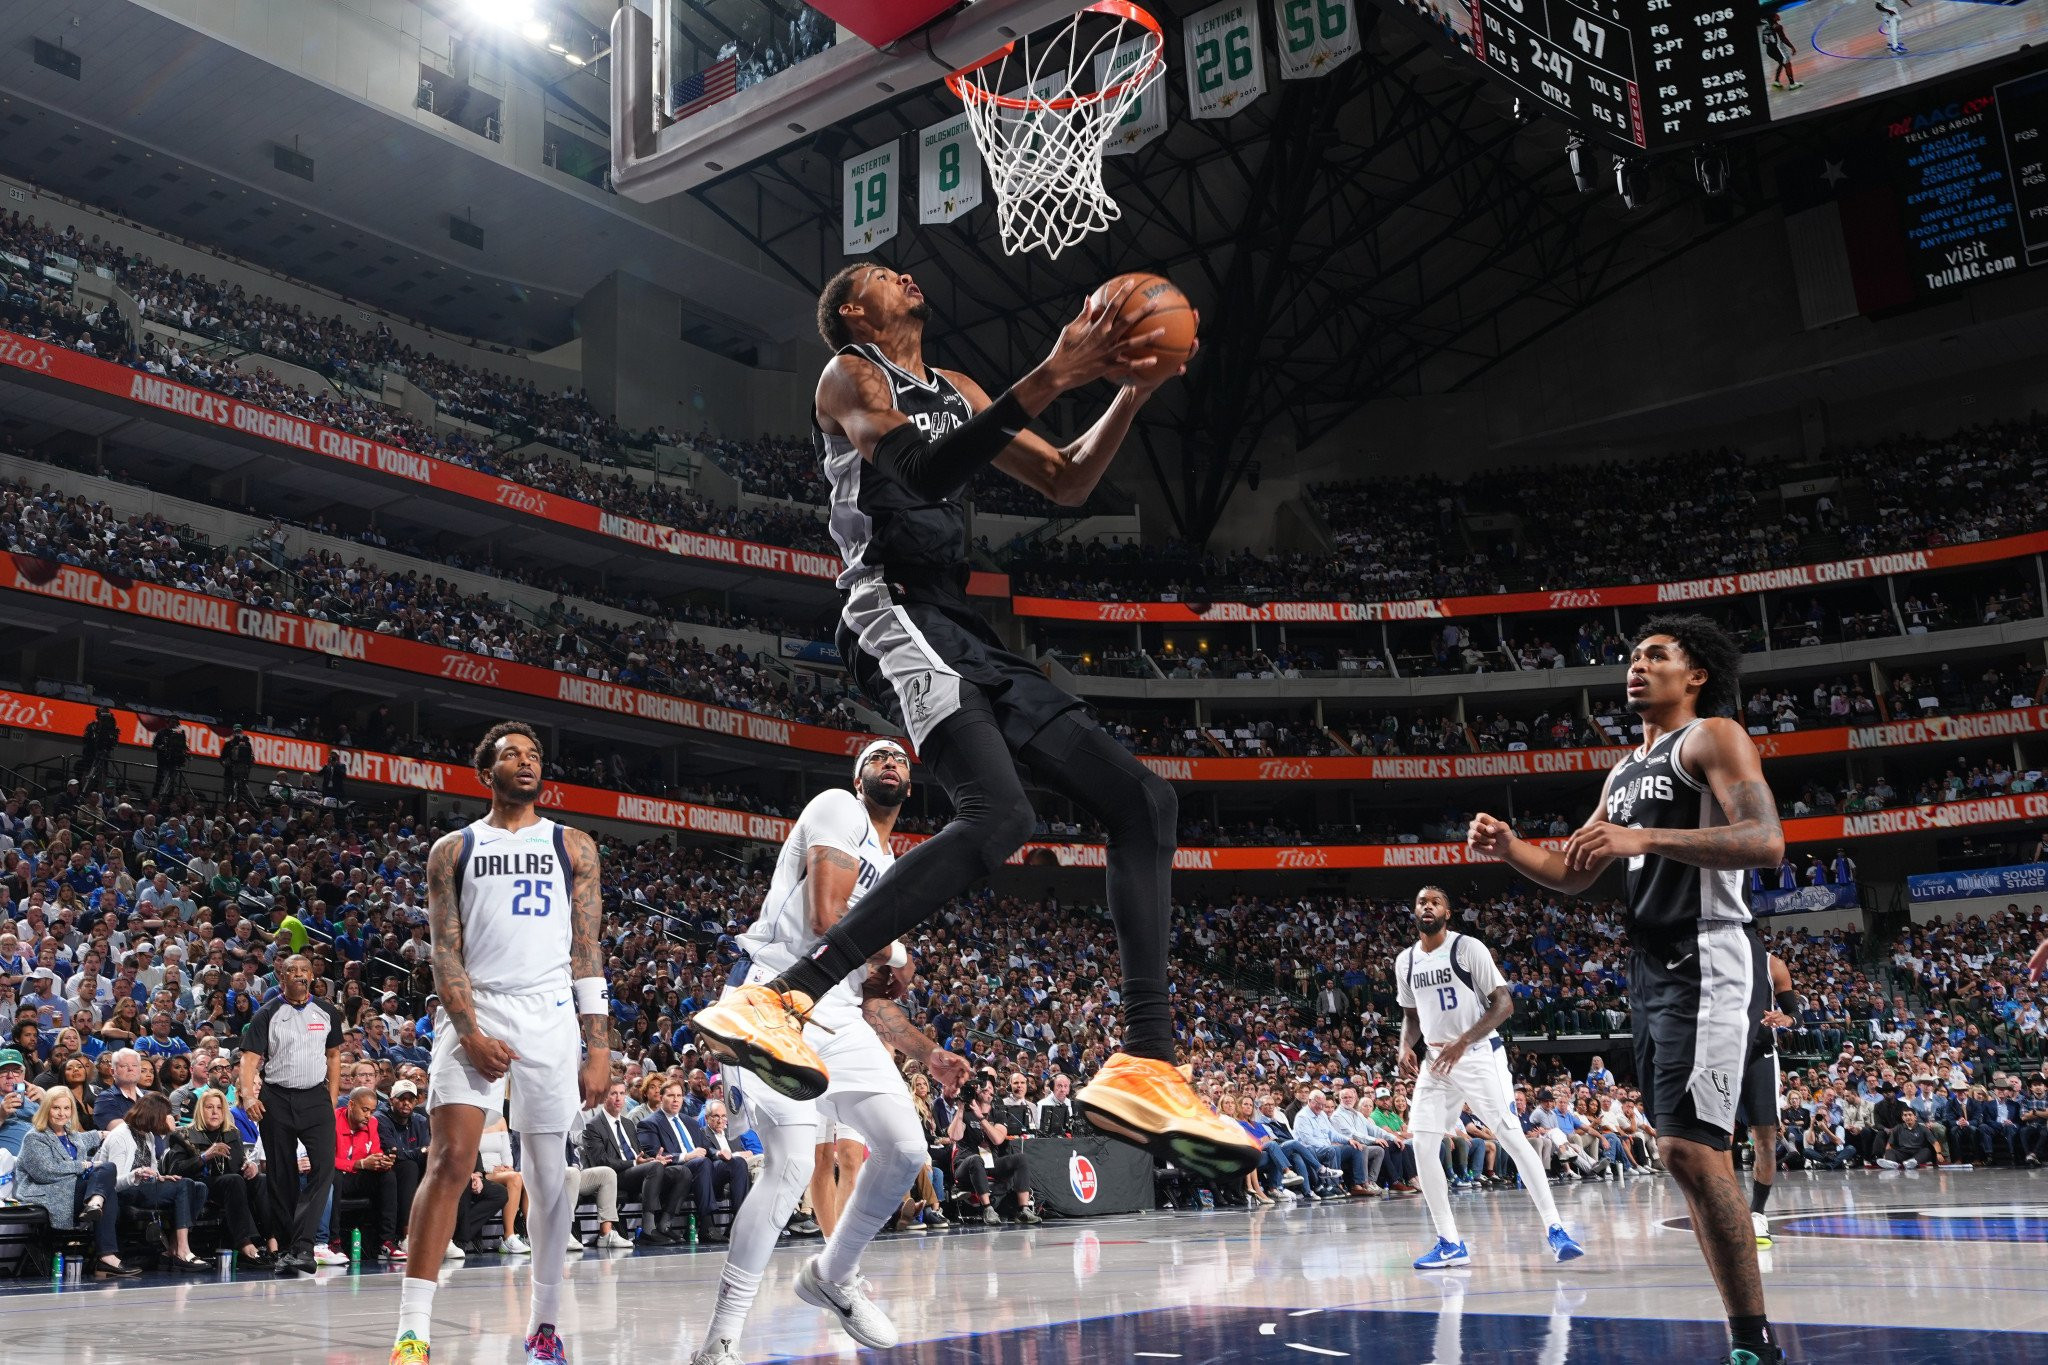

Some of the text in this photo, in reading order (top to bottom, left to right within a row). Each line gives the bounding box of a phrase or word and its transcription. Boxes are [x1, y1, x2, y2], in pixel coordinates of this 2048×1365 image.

[1197, 6, 1243, 36] LEHTINEN
[1284, 0, 1347, 54] 56
[1483, 12, 1516, 44] TOL 5
[1650, 7, 1735, 37] FG 19/36
[1333, 45, 1352, 58] 2009
[1573, 16, 1606, 60] 47
[1653, 28, 1728, 55] 3-PT 3/8
[1196, 25, 1253, 93] 26
[1489, 42, 1520, 74] FLS 5
[1529, 38, 1574, 85] 2:47
[1655, 43, 1735, 72] FT 6/13
[1588, 74, 1623, 102] TOL 5
[1658, 69, 1747, 98] FG 52.8%
[1630, 86, 1643, 143] BONUS
[1661, 87, 1749, 116] 3-PT 37.5%
[1592, 103, 1627, 130] FLS 5
[1663, 105, 1752, 133] FT 46.2%
[1904, 113, 1984, 144] TELL US ABOUT
[1921, 132, 1970, 153] FACILITY
[2014, 128, 2040, 143] FGS
[851, 153, 891, 178] MASTERTON
[1907, 136, 1987, 167] MAINTENANCE
[1922, 153, 1977, 177] SECURITY
[938, 141, 960, 193] 8
[1921, 162, 1983, 187] CONCERNS
[2022, 173, 2048, 187] FGS
[853, 171, 887, 228] 19
[1906, 178, 1976, 205] EXPERIENCE
[1938, 189, 1973, 205] STAFF
[1908, 224, 1940, 239] FOOD
[1952, 203, 2015, 227] BEVERAGE
[1920, 194, 1997, 223] UNRULY FANS
[1919, 218, 2008, 250] ANYTHING ELSE
[1944, 240, 1989, 266] visit
[1926, 256, 2018, 290] TellAAC.com
[130, 374, 431, 483] AMERICA'S ORIGINAL CRAFT VODKA
[496, 483, 547, 515] Tito's
[599, 512, 839, 580] AMERICA'S ORIGINAL CRAFT VODKA
[1656, 551, 1928, 602] AMERICA'S ORIGINAL CRAFT VODKA
[1099, 602, 1146, 622] Tito's
[1275, 601, 1337, 622] ORIGINAL
[1340, 602, 1383, 621] CRAFT
[1387, 599, 1437, 620] VODKA
[1549, 589, 1602, 609] Tito's
[136, 587, 231, 631] ORIGINAL
[236, 607, 299, 644] CRAFT
[303, 622, 367, 661] VODKA
[440, 653, 500, 685] Tito's
[557, 676, 792, 746] AMERICA'S ORIGINAL CRAFT VODKA
[1847, 722, 1938, 750] AMERICA'S
[1945, 712, 2035, 741] ORIGINAL
[387, 756, 446, 791] VODKA
[1258, 760, 1314, 780] Tito's
[1372, 756, 1452, 779] AMERICA'S
[1454, 751, 1529, 776] ORIGINAL
[1533, 750, 1585, 773] CRAFT
[616, 795, 685, 829] AMERICA'S
[688, 807, 745, 838] ORIGINAL
[748, 816, 787, 842] CRAFT
[1843, 810, 1930, 838] AMERICA'S
[1932, 801, 2021, 829] ORIGINAL
[474, 853, 554, 879] DALLAS
[1276, 849, 1328, 868] Tito's
[1383, 845, 1461, 866] AMERICA'S
[2002, 868, 2046, 881] SOUND
[2007, 877, 2045, 889] STAGE
[512, 879, 553, 917] 25
[1912, 884, 1956, 898] ULTRA
[1413, 967, 1452, 989] DALLAS
[1437, 986, 1458, 1012] 13
